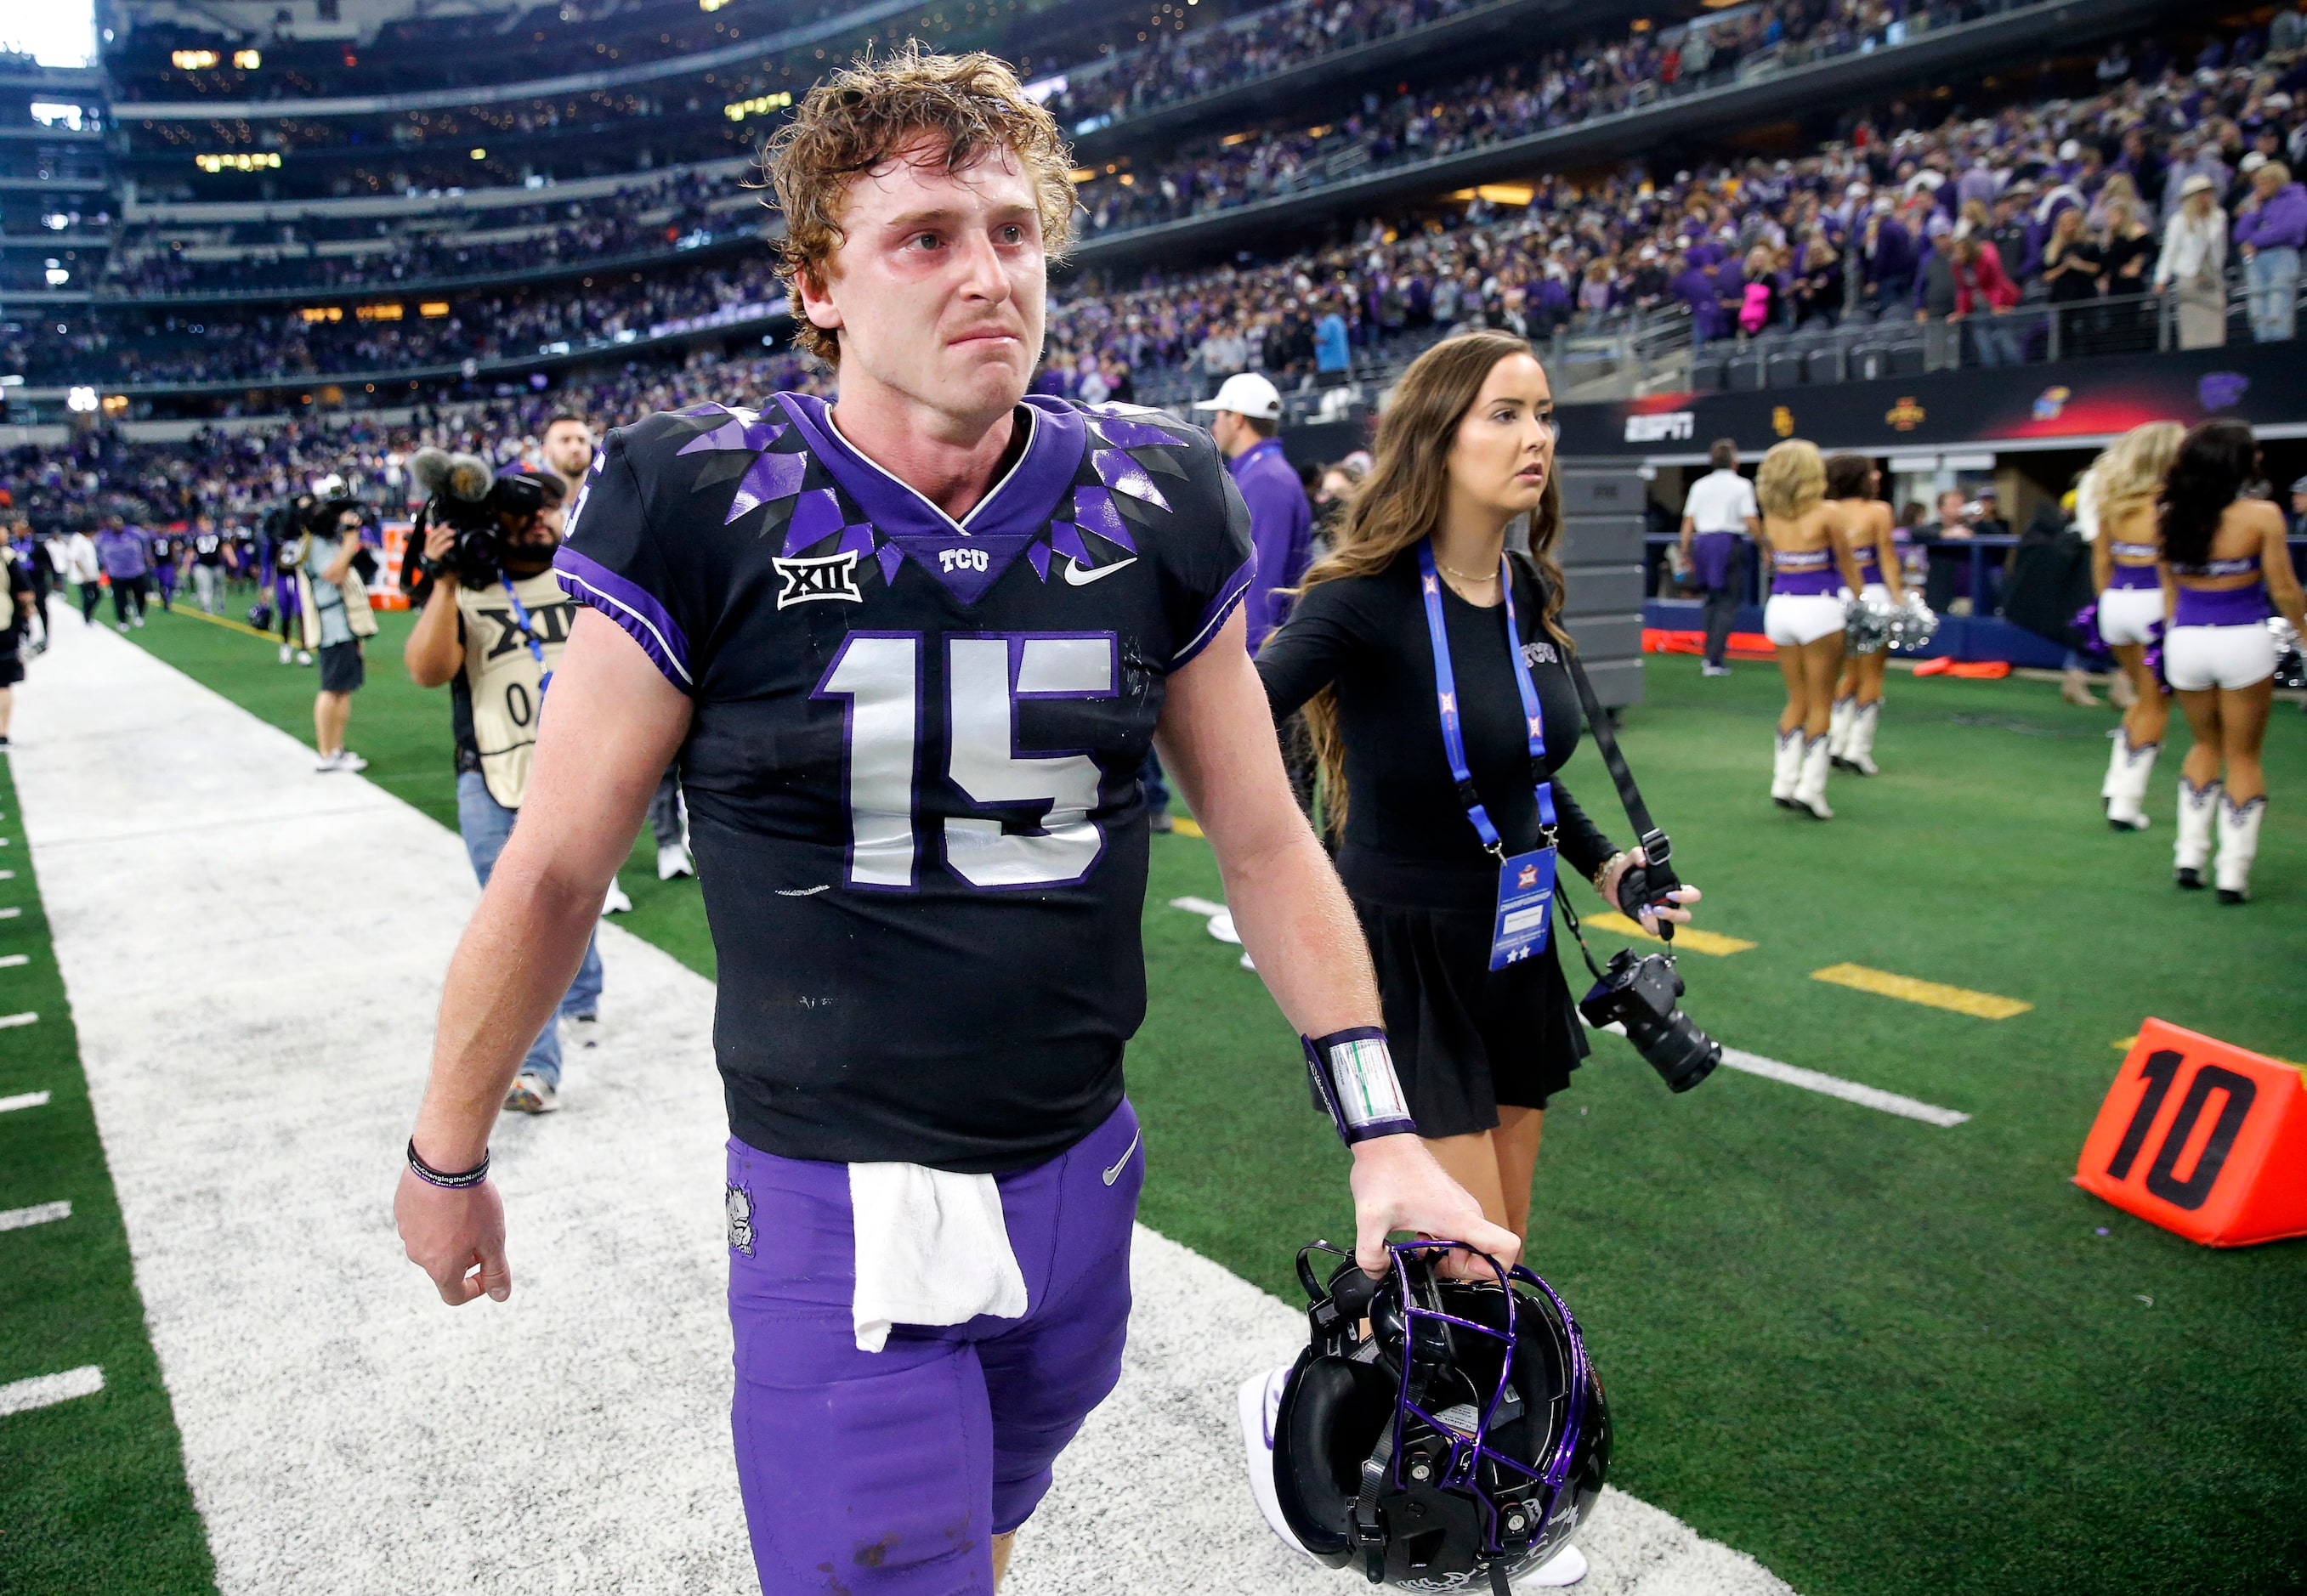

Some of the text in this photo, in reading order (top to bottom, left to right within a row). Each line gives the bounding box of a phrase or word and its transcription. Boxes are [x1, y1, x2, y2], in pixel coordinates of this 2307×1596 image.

[1624, 411, 1695, 443] ESPN
[774, 555, 858, 604] XII
[938, 548, 989, 574] TCU
[1520, 642, 1558, 668] TCU
[811, 631, 1119, 891] 15
[2106, 1049, 2257, 1211] 10
